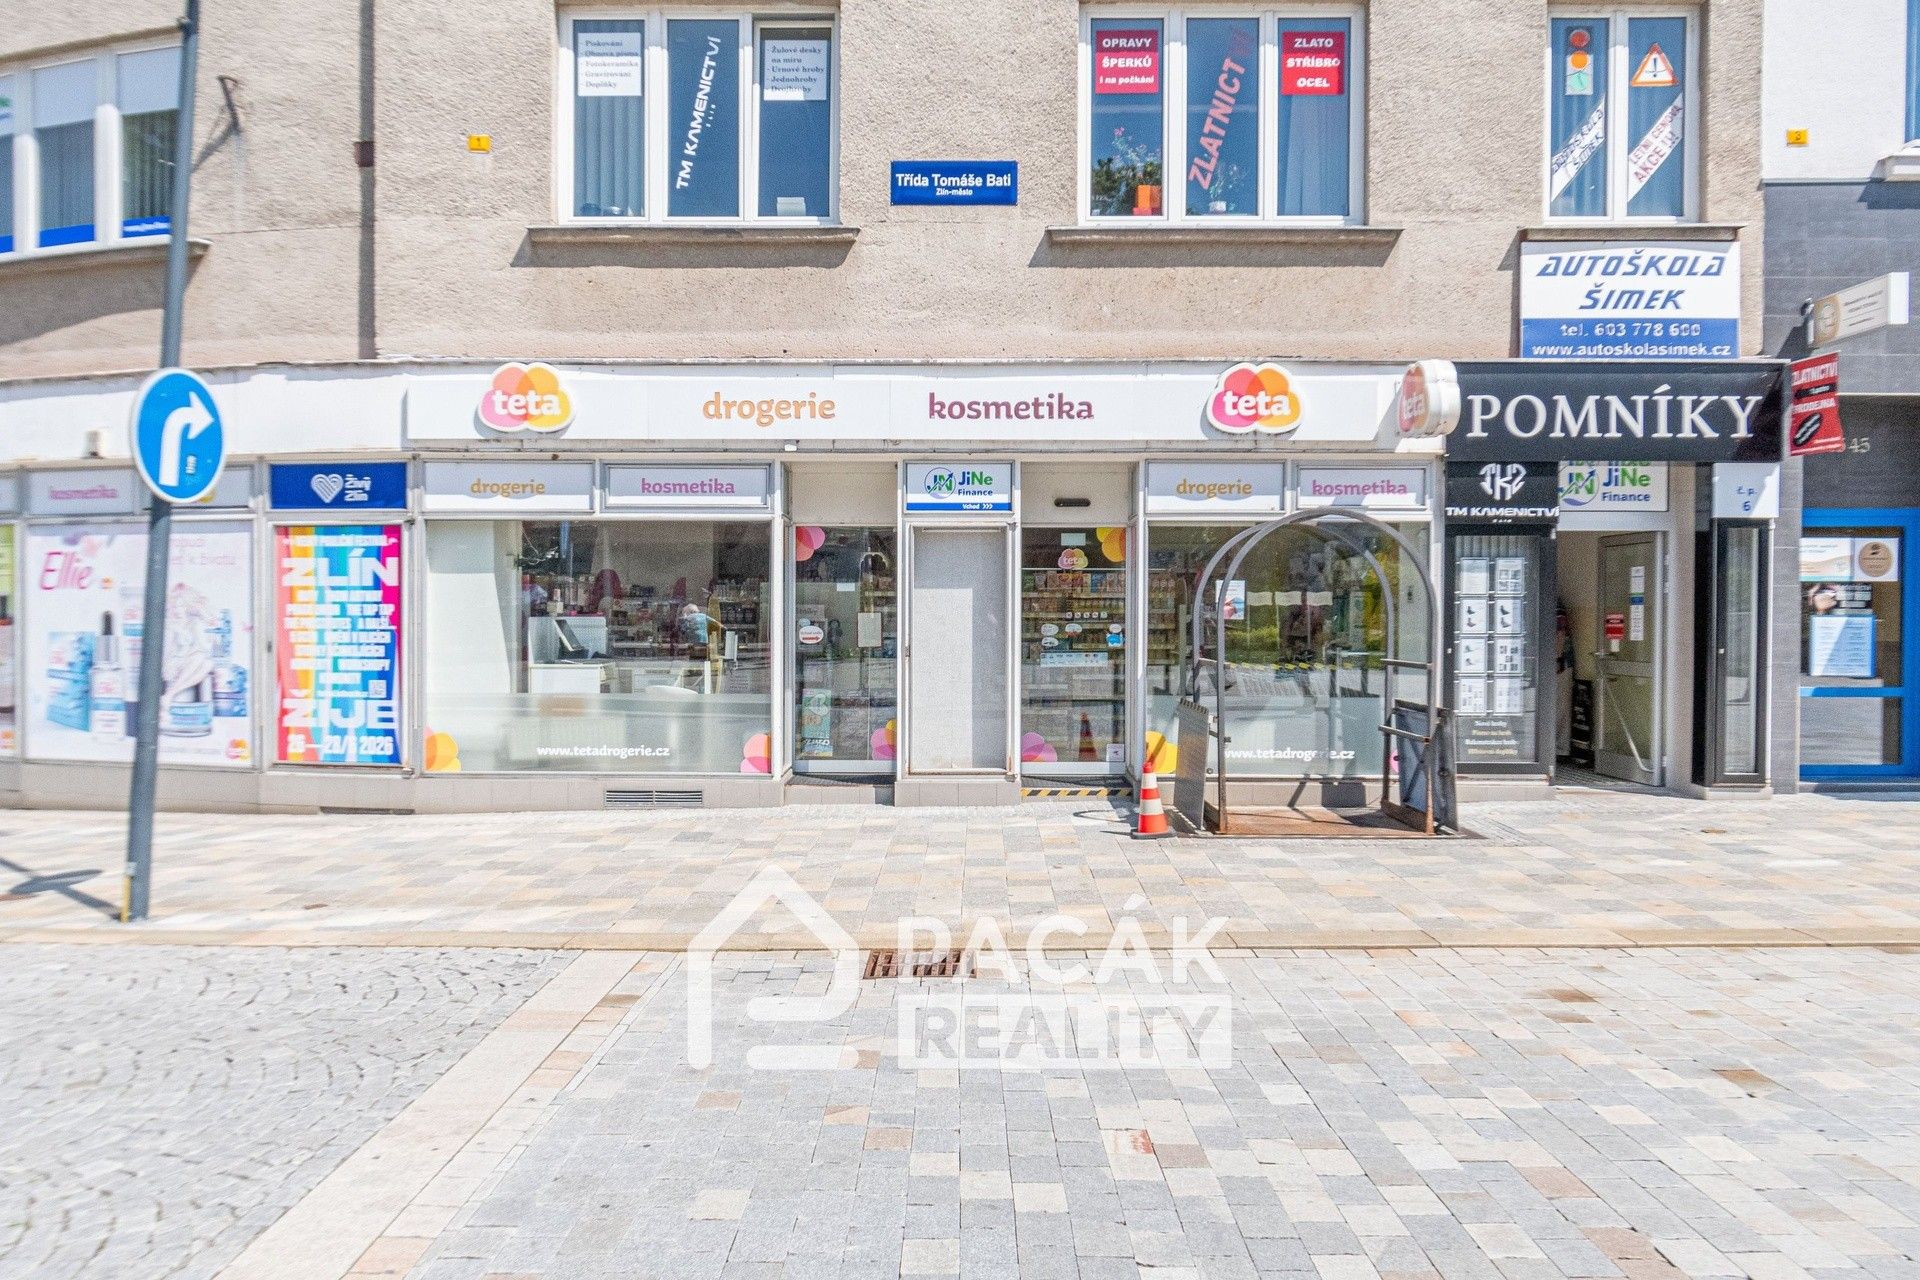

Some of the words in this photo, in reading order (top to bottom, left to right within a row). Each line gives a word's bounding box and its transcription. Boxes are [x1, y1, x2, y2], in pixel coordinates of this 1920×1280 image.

[1102, 38, 1152, 48] OPRAVY
[1294, 38, 1334, 48] ZLATO
[1286, 55, 1341, 68] STŘÍBRO
[1296, 77, 1330, 88] OCEL
[1188, 30, 1250, 190] ZLATNICT
[676, 160, 694, 190] TM
[895, 173, 929, 187] Třída
[932, 173, 983, 187] Tomáše
[986, 173, 1012, 187] Bati
[936, 188, 974, 197] Zlín-město
[1536, 249, 1727, 277] AUTOŠKOLA
[1578, 281, 1686, 310] ŠIMEK
[1560, 323, 1589, 337] tel.
[1594, 323, 1627, 337] 603
[1631, 323, 1664, 337] 778
[1531, 342, 1732, 356] www.autoskolasimek.cz
[492, 389, 561, 418] teta
[702, 391, 836, 428] drogerie
[928, 391, 1095, 420] kosmetika
[1222, 389, 1291, 417] teta
[1466, 383, 1763, 439] POMNÍKY
[958, 471, 994, 486] JiNe
[1602, 467, 1651, 487] JiNe
[470, 477, 546, 499] drogerie
[641, 477, 736, 495] kosmetika
[958, 488, 994, 497] Finance
[1175, 478, 1253, 499] drogerie
[1311, 479, 1409, 496] kosmetika
[1601, 491, 1651, 502] Finance
[1445, 507, 1468, 517] TM
[281, 548, 400, 587] ZLÍN
[281, 688, 398, 730] ŽIJE
[536, 744, 671, 760] www.tetadrogerie.cz
[1222, 747, 1356, 762] www.tetadroge.cz
